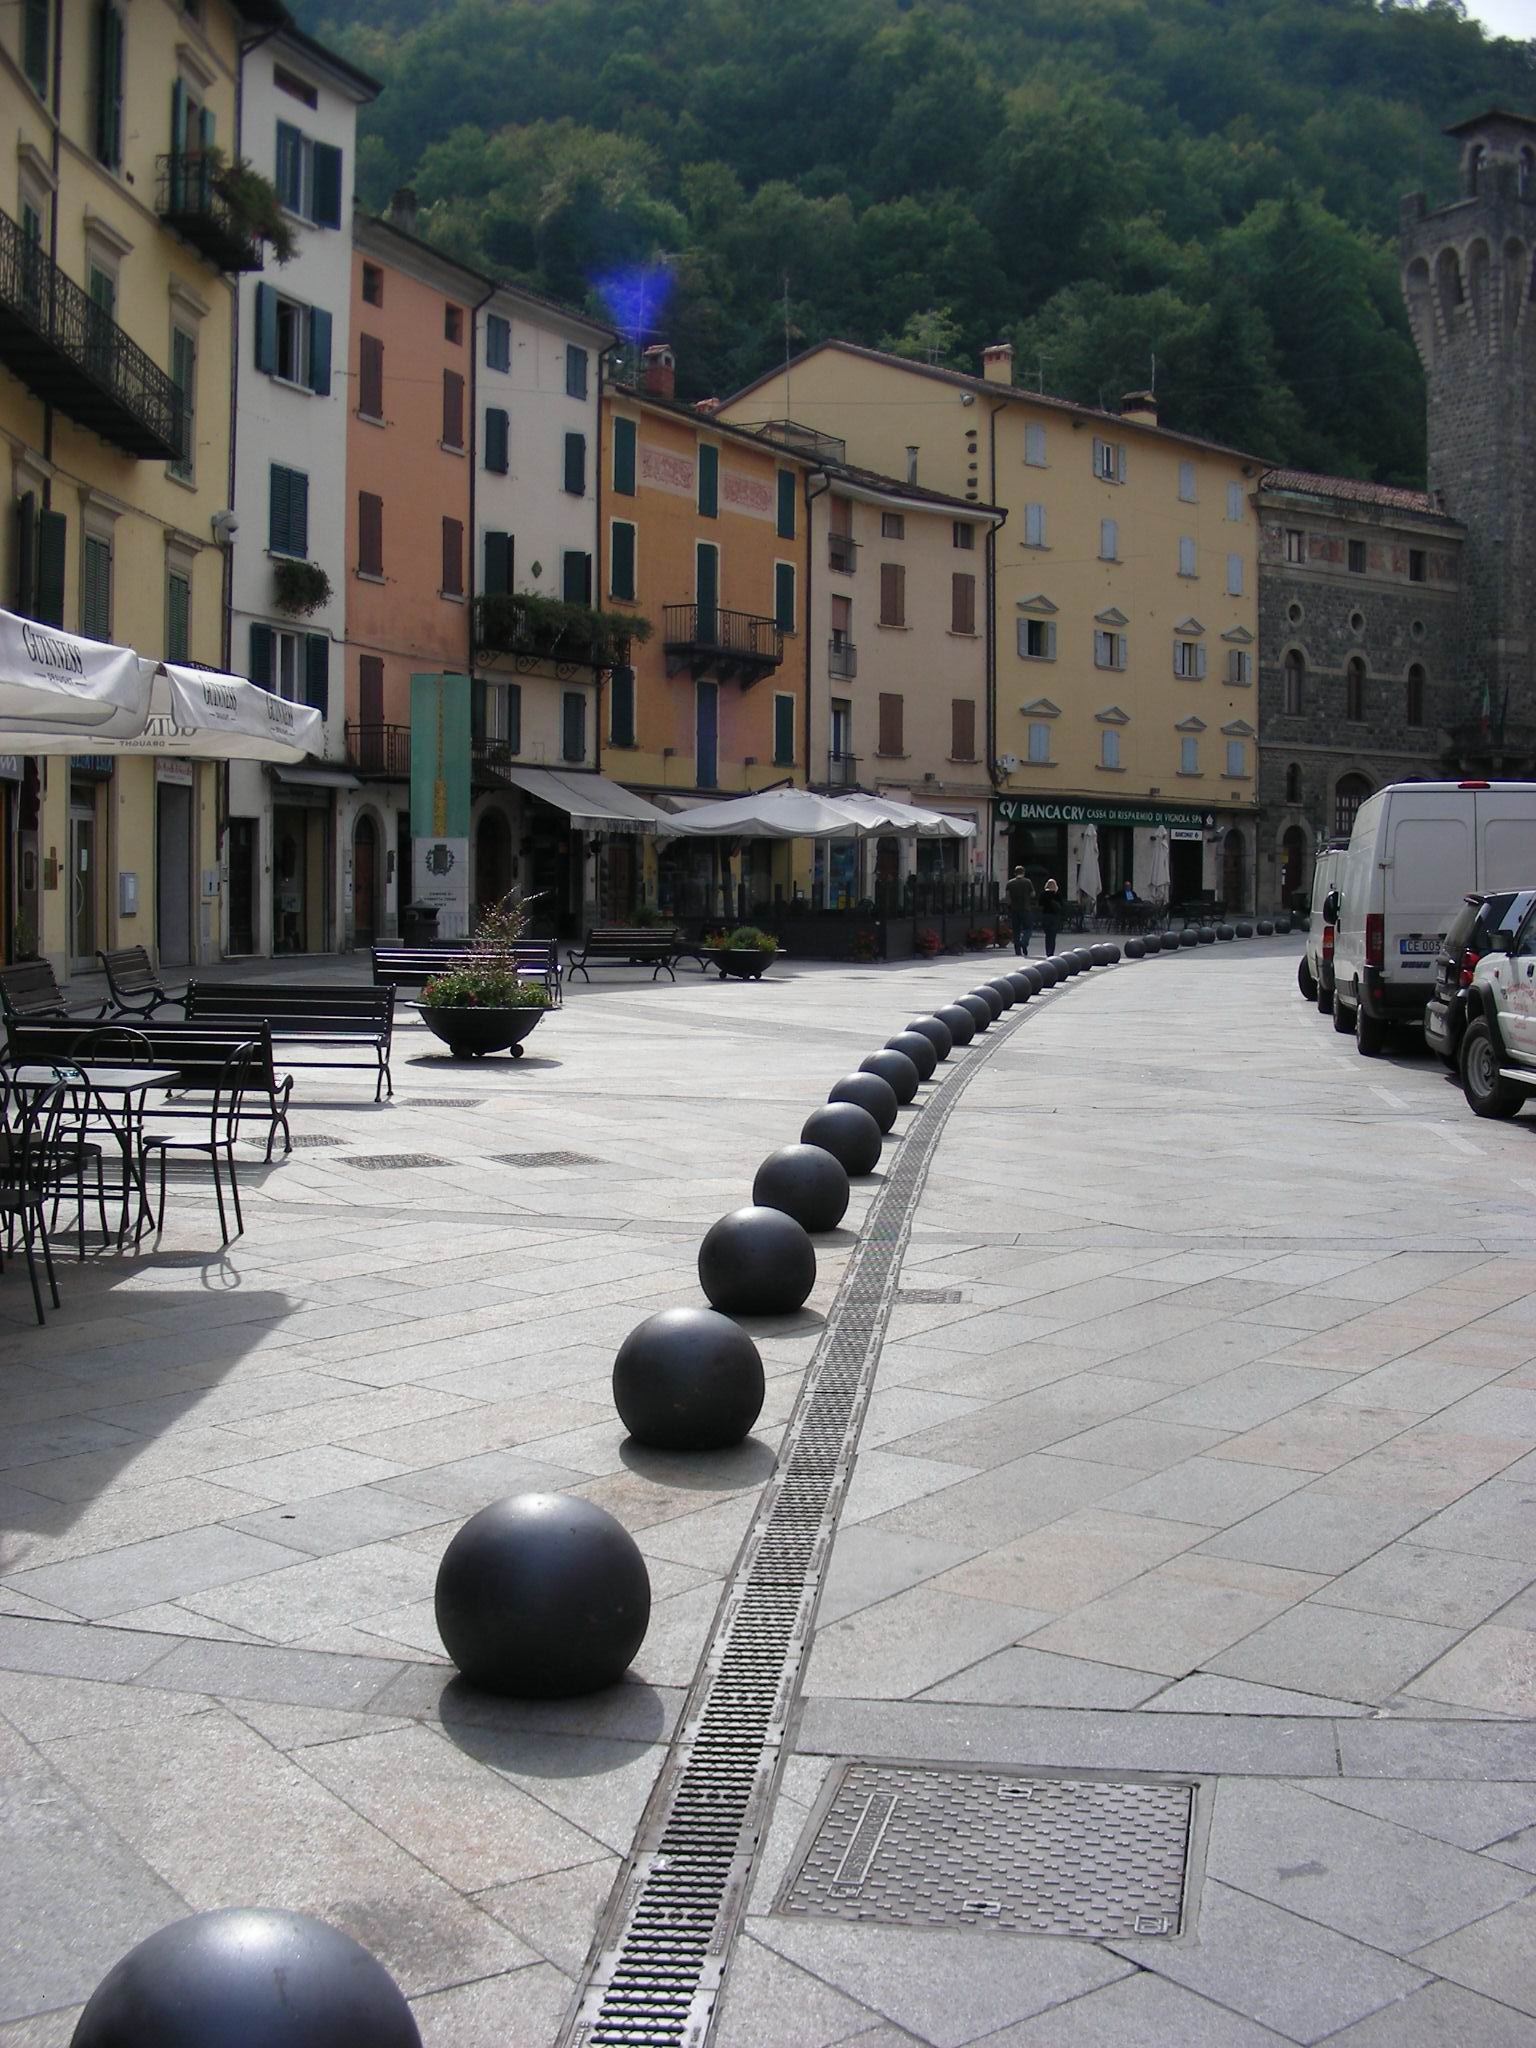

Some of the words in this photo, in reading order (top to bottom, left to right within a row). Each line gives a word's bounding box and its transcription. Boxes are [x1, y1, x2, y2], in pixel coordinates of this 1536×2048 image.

[22, 623, 83, 674] GUINNESS
[1020, 803, 1061, 819] BANCA
[1062, 805, 1085, 820] CRV
[1086, 809, 1106, 819] CASSA
[1109, 810, 1116, 819] DI
[1117, 810, 1153, 821] RISPARMIO
[1155, 813, 1162, 823] DI
[1165, 813, 1189, 824] VIGNOLA
[1408, 941, 1420, 951] CE
